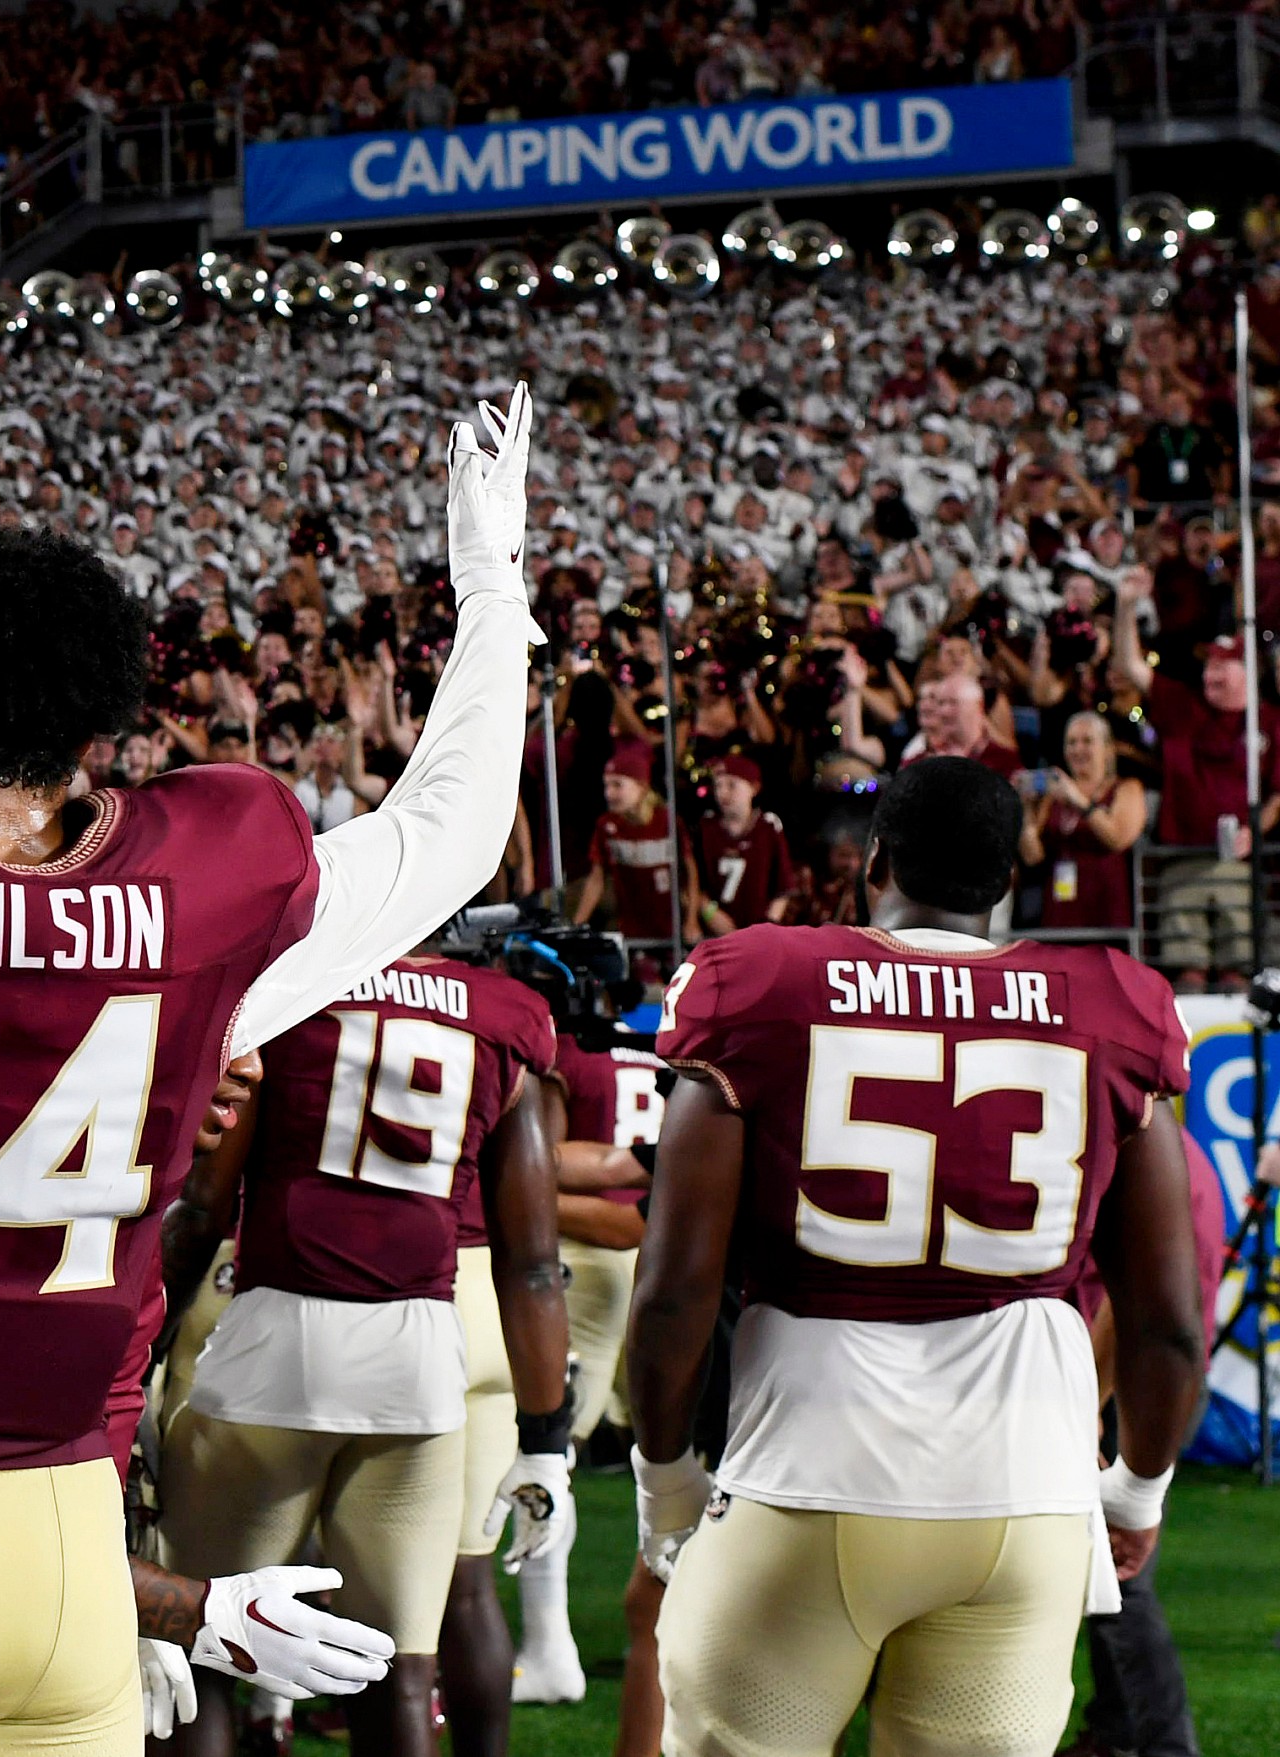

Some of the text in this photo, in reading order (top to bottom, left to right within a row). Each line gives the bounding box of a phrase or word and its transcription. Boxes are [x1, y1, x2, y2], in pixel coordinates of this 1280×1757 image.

[348, 97, 954, 201] CAMPING WORLD
[718, 857, 746, 904] 7
[334, 968, 469, 1021] DMOND
[826, 960, 1064, 1025] SMITH JR.
[317, 1009, 476, 1200] 19
[795, 1024, 1088, 1277] 53
